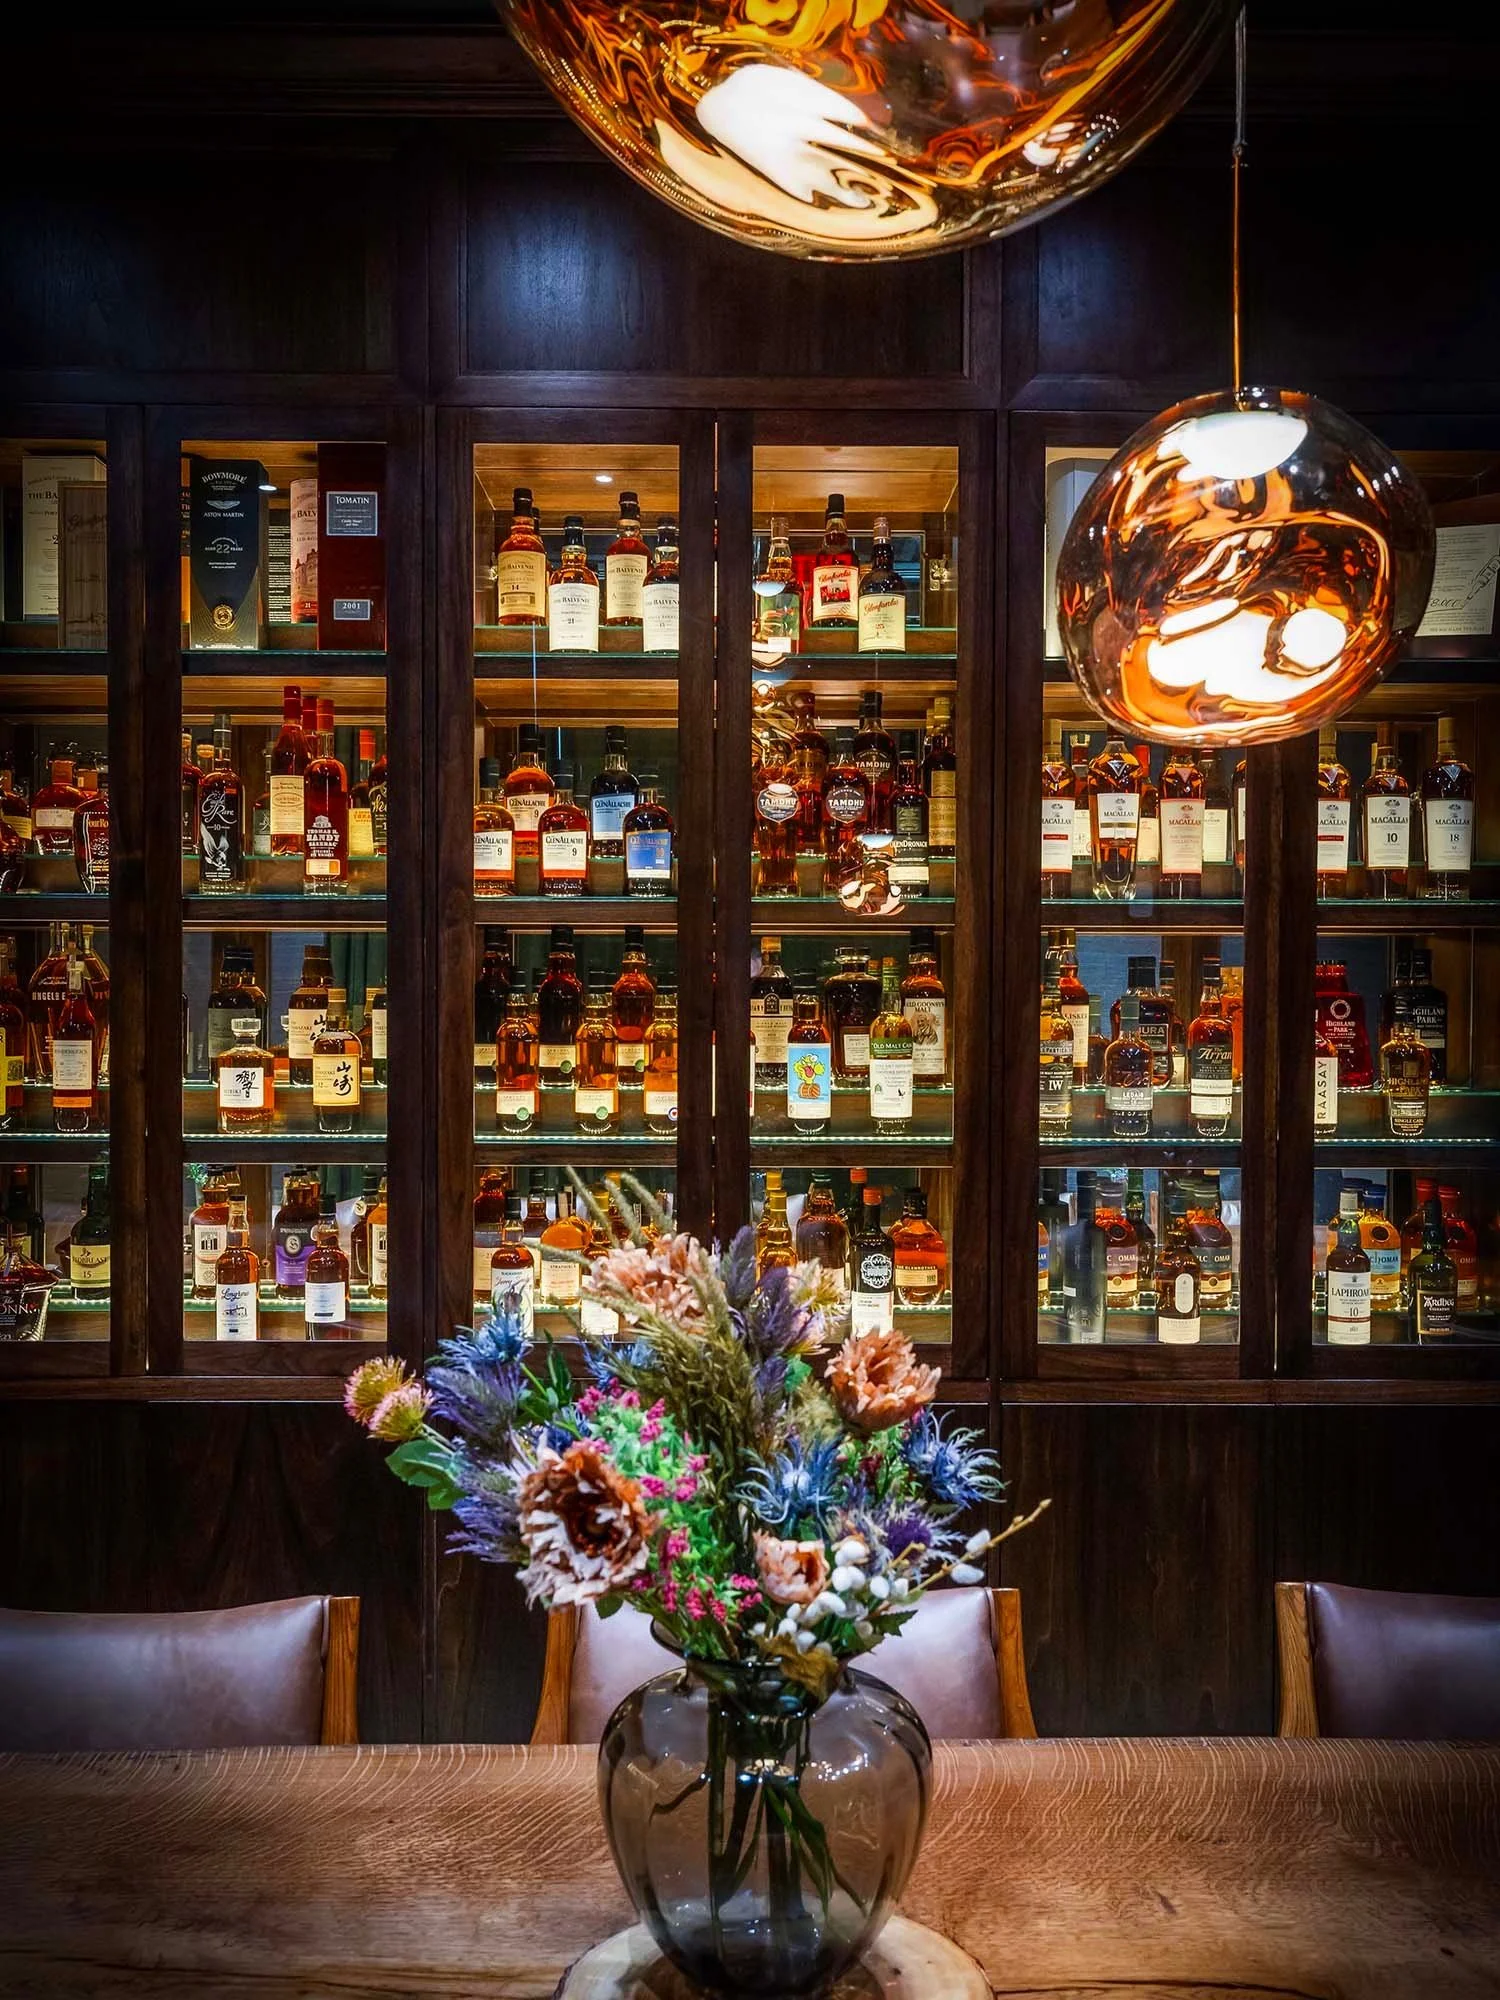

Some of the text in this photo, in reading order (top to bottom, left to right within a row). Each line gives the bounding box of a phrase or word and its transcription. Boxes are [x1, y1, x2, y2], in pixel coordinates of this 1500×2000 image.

[201, 471, 248, 485] BOWMORE
[335, 496, 370, 505] TOMATIN
[203, 511, 245, 519] ASTON MARTIN
[216, 543, 231, 555] 22
[342, 602, 362, 610] 2001
[855, 760, 891, 769] TAMDHU
[760, 797, 797, 807] TAMDHU
[828, 799, 865, 807] TAMDHU
[533, 809, 540, 818] 9
[1370, 816, 1409, 825] MACALLAN
[1435, 818, 1470, 826] MACALLAN
[306, 834, 340, 842] HANDY
[474, 834, 509, 845] LENALLACHIE
[1387, 833, 1398, 843] 10
[1450, 833, 1460, 842] 18
[497, 847, 503, 856] 9
[571, 847, 578, 857] 9
[1416, 1015, 1437, 1024] PARK
[1196, 1048, 1232, 1060] Arran
[333, 1061, 354, 1097] 山崎
[1316, 1060, 1328, 1120] RAASAY
[1398, 1086, 1422, 1095] PARK
[83, 1270, 92, 1279] 15
[1350, 1306, 1359, 1317] 10
